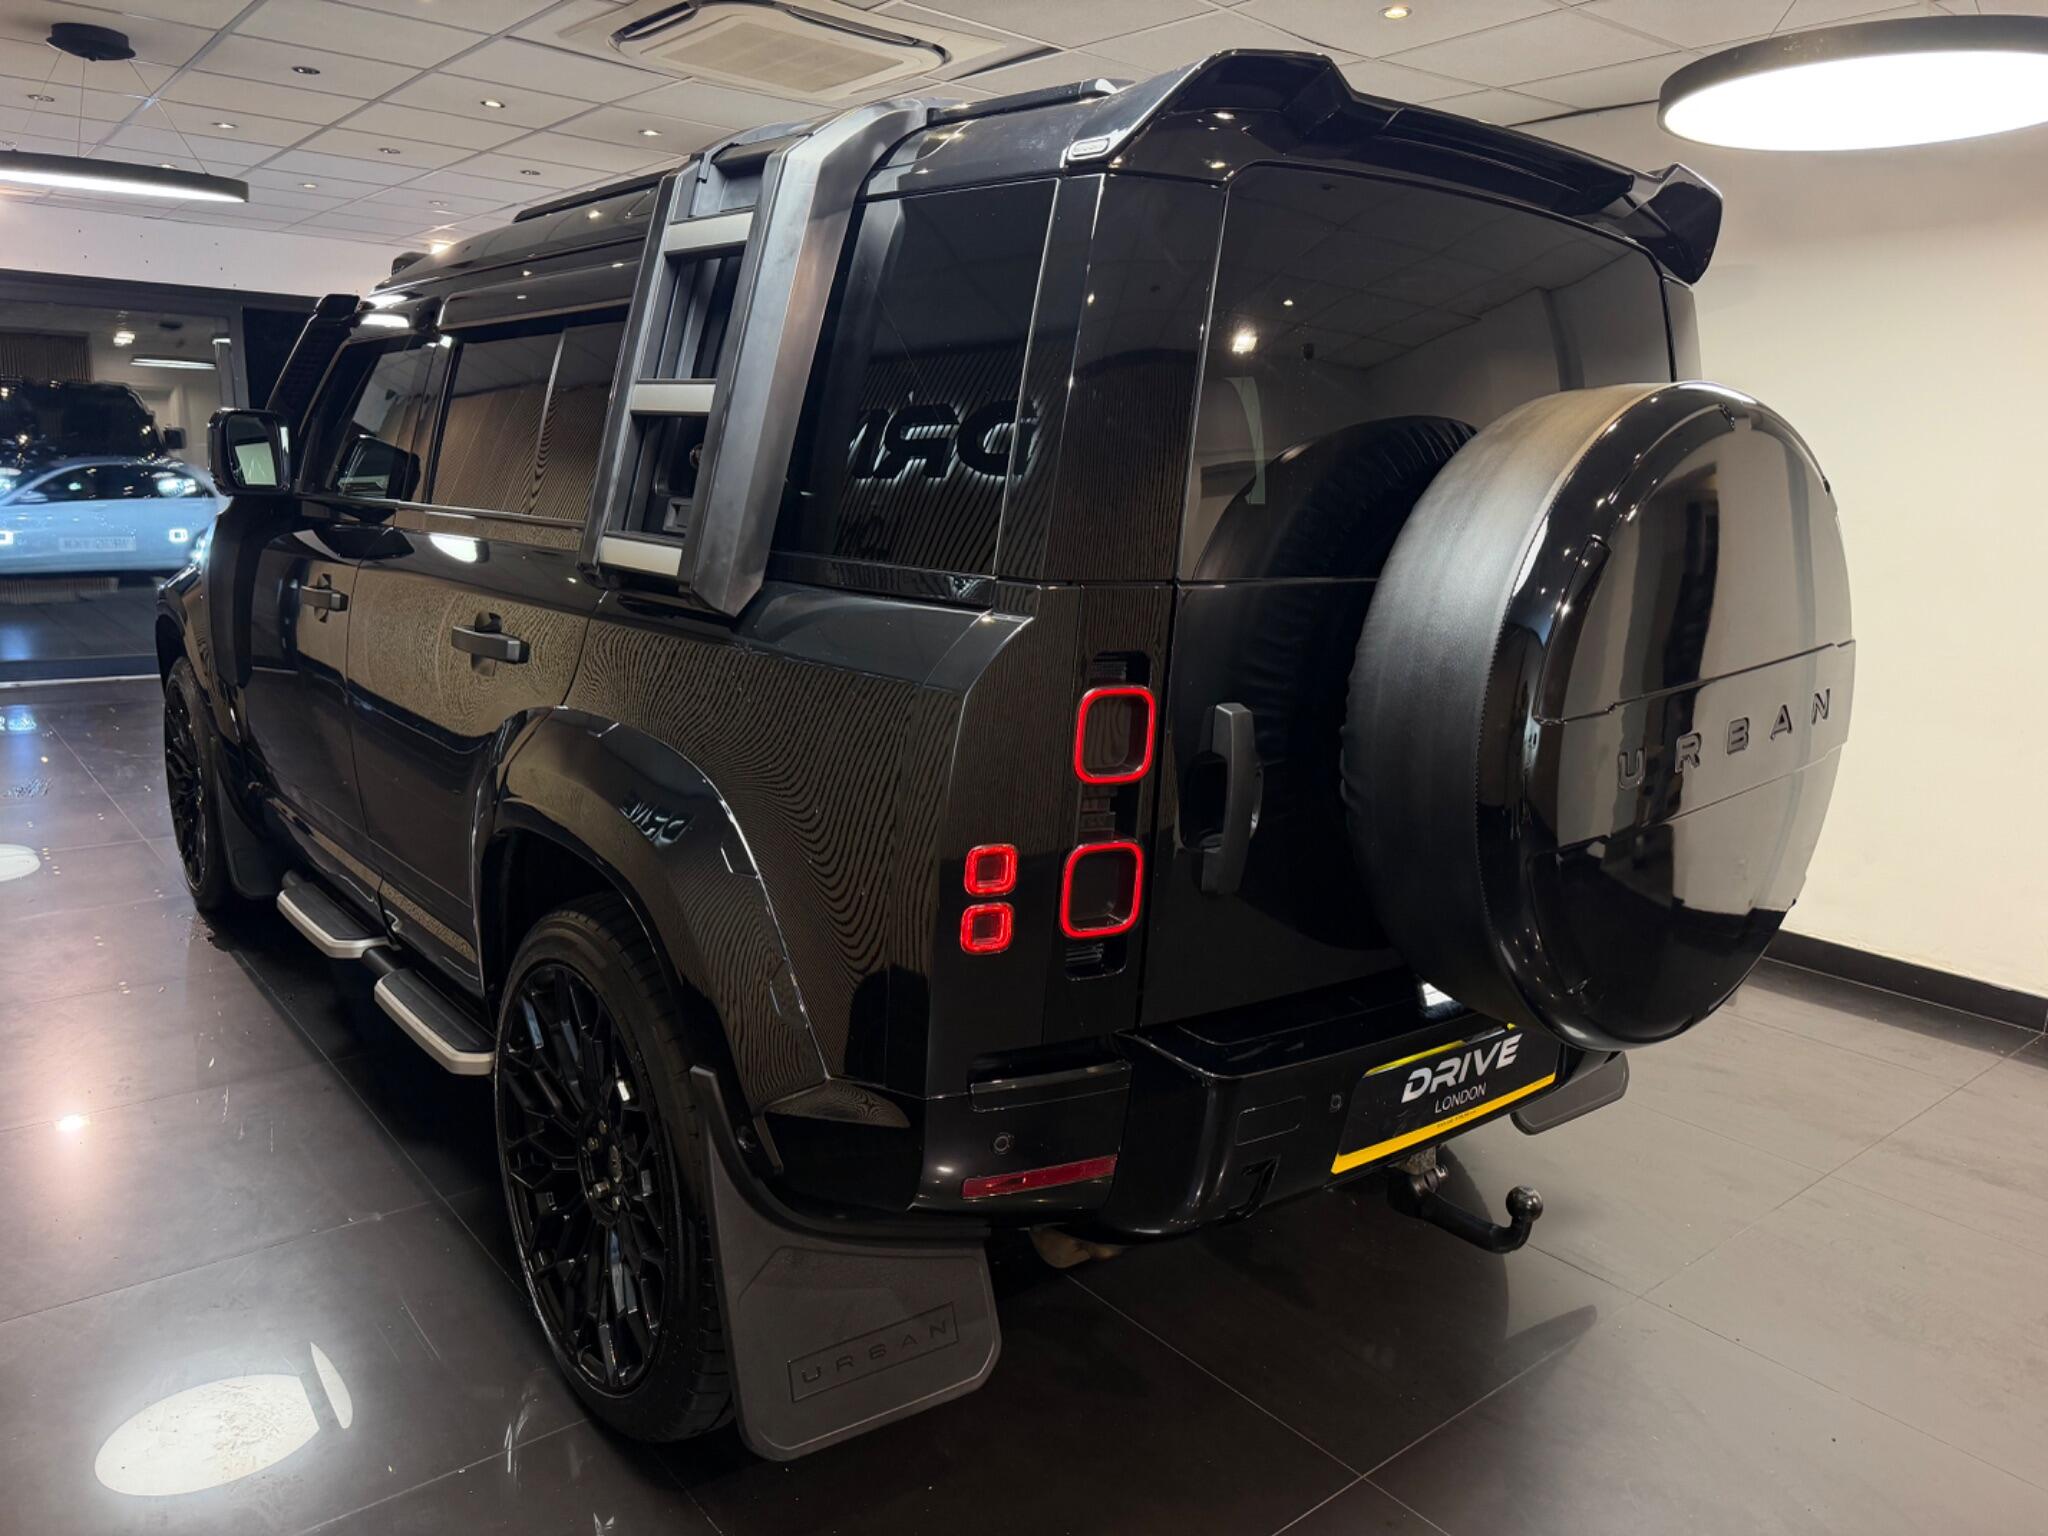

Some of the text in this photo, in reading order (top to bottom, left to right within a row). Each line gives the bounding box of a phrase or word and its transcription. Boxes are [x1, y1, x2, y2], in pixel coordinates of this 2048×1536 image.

[1617, 688, 1831, 790] URBAN
[1401, 1033, 1523, 1103] DRIVE
[1434, 1082, 1487, 1113] LONDON
[801, 1320, 947, 1383] URBAN
